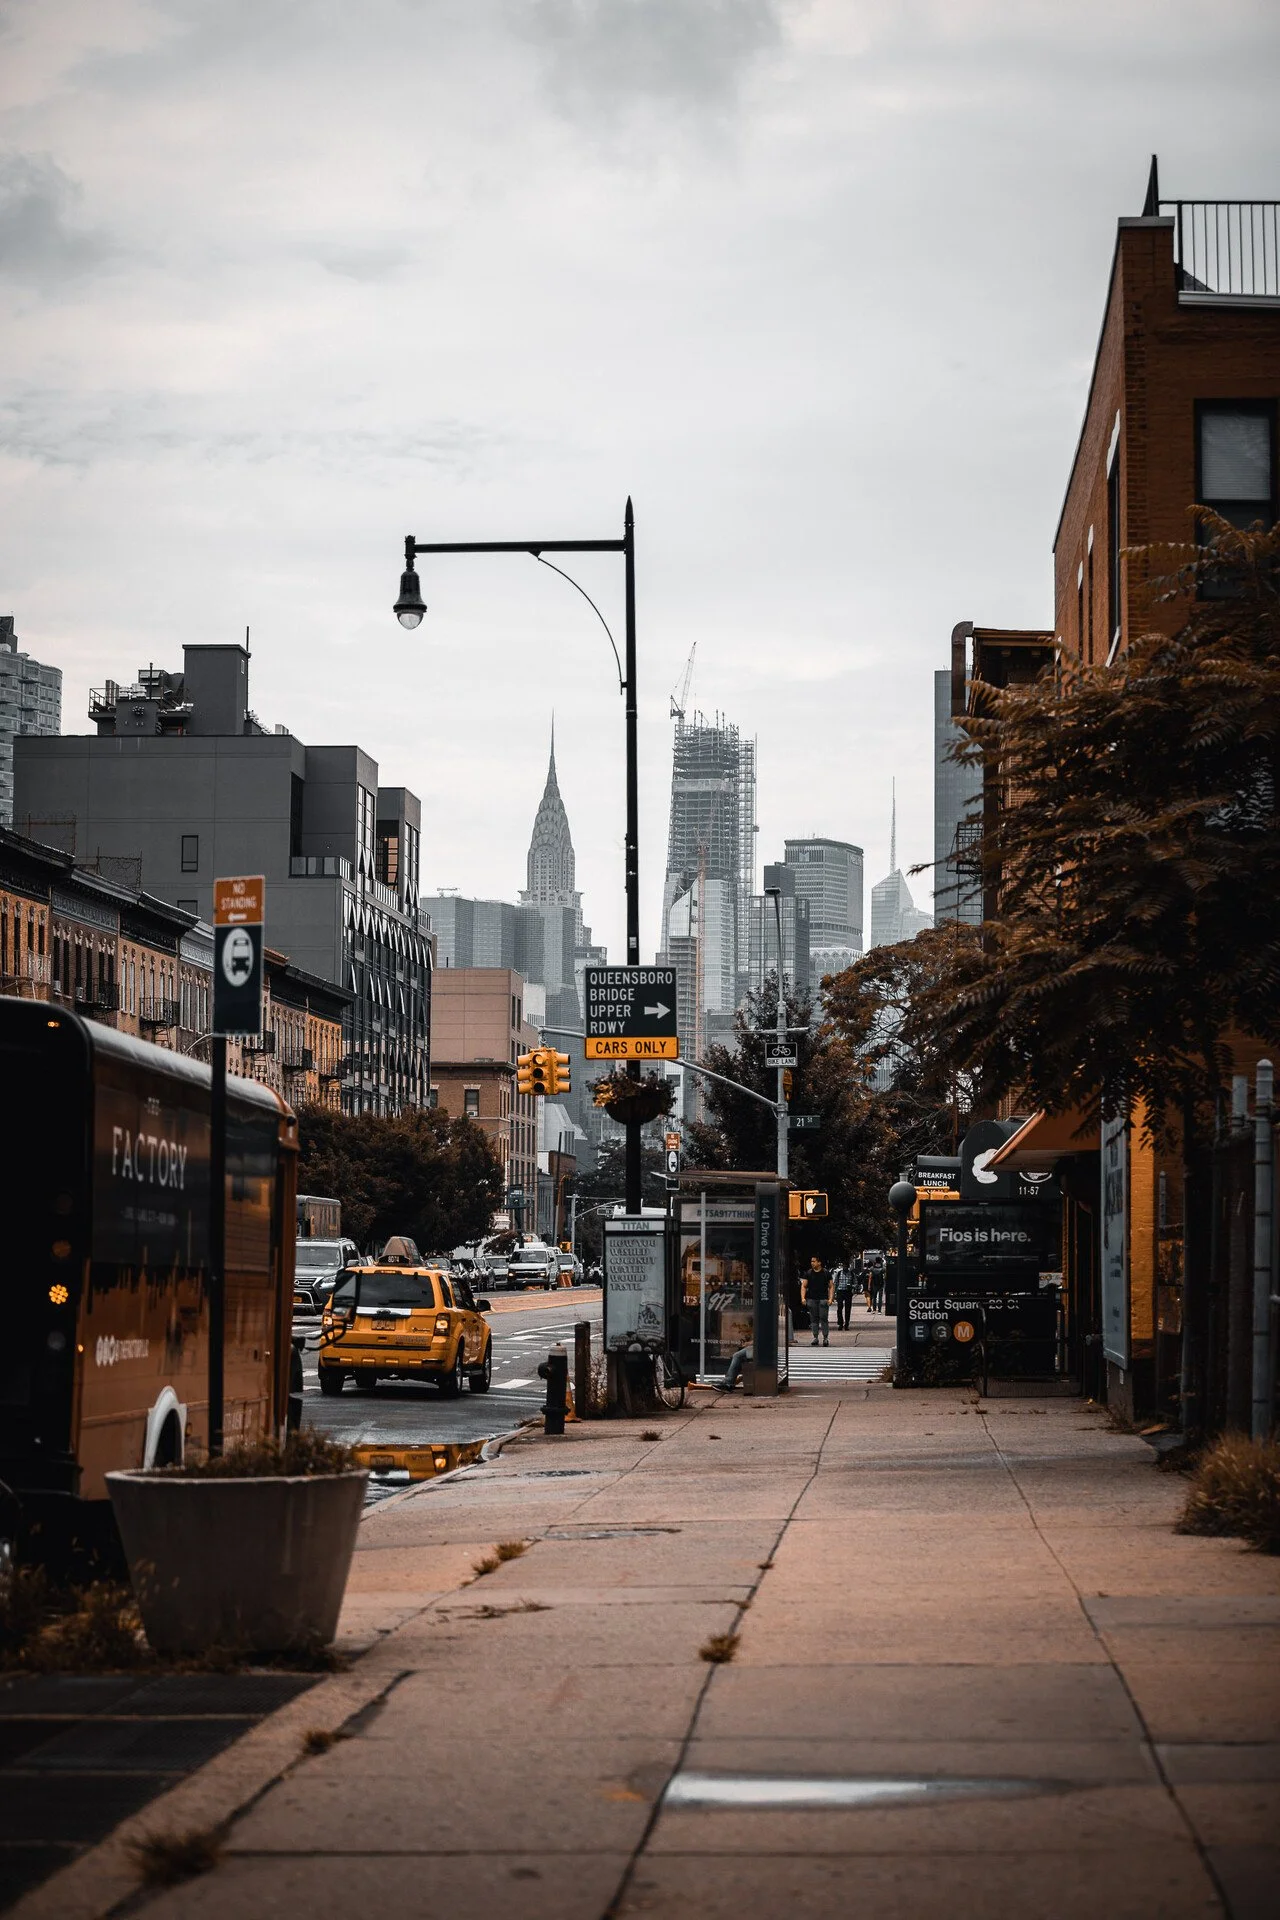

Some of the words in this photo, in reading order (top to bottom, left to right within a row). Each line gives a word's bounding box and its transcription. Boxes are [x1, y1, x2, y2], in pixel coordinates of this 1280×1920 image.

[232, 881, 246, 895] NO
[221, 895, 257, 911] STANDING
[590, 972, 673, 985] QUEENSBORO
[590, 988, 635, 1001] BRIDGE
[590, 1005, 631, 1017] UPPER
[590, 1021, 625, 1034] RDWY
[595, 1041, 628, 1054] CARS
[635, 1041, 667, 1054] ONLY
[781, 1057, 795, 1065] LANE
[796, 1117, 804, 1127] 21
[112, 1126, 187, 1190] FACTORY
[918, 1171, 956, 1180] BREAKFAST
[1018, 1186, 1039, 1195] 11-57
[761, 1207, 770, 1219] 44
[621, 1222, 650, 1230] TITAN
[761, 1221, 770, 1246] Drive
[939, 1227, 973, 1242] Fios
[975, 1227, 989, 1242] is
[990, 1227, 1032, 1242] here.
[609, 1239, 635, 1248] HOW
[635, 1239, 656, 1248] YOU
[609, 1248, 649, 1257] WISHED
[761, 1248, 770, 1256] &
[609, 1257, 657, 1265] COCONUT
[761, 1258, 770, 1269] 21
[609, 1266, 646, 1274] WATER
[609, 1274, 648, 1283] WOULD
[760, 1272, 770, 1301] Street
[683, 1295, 698, 1304] IT'S
[708, 1292, 735, 1311] 917
[909, 1299, 940, 1310] Court
[909, 1310, 949, 1320] Station
[914, 1325, 924, 1338] E
[935, 1325, 947, 1338] G
[957, 1325, 970, 1338] M
